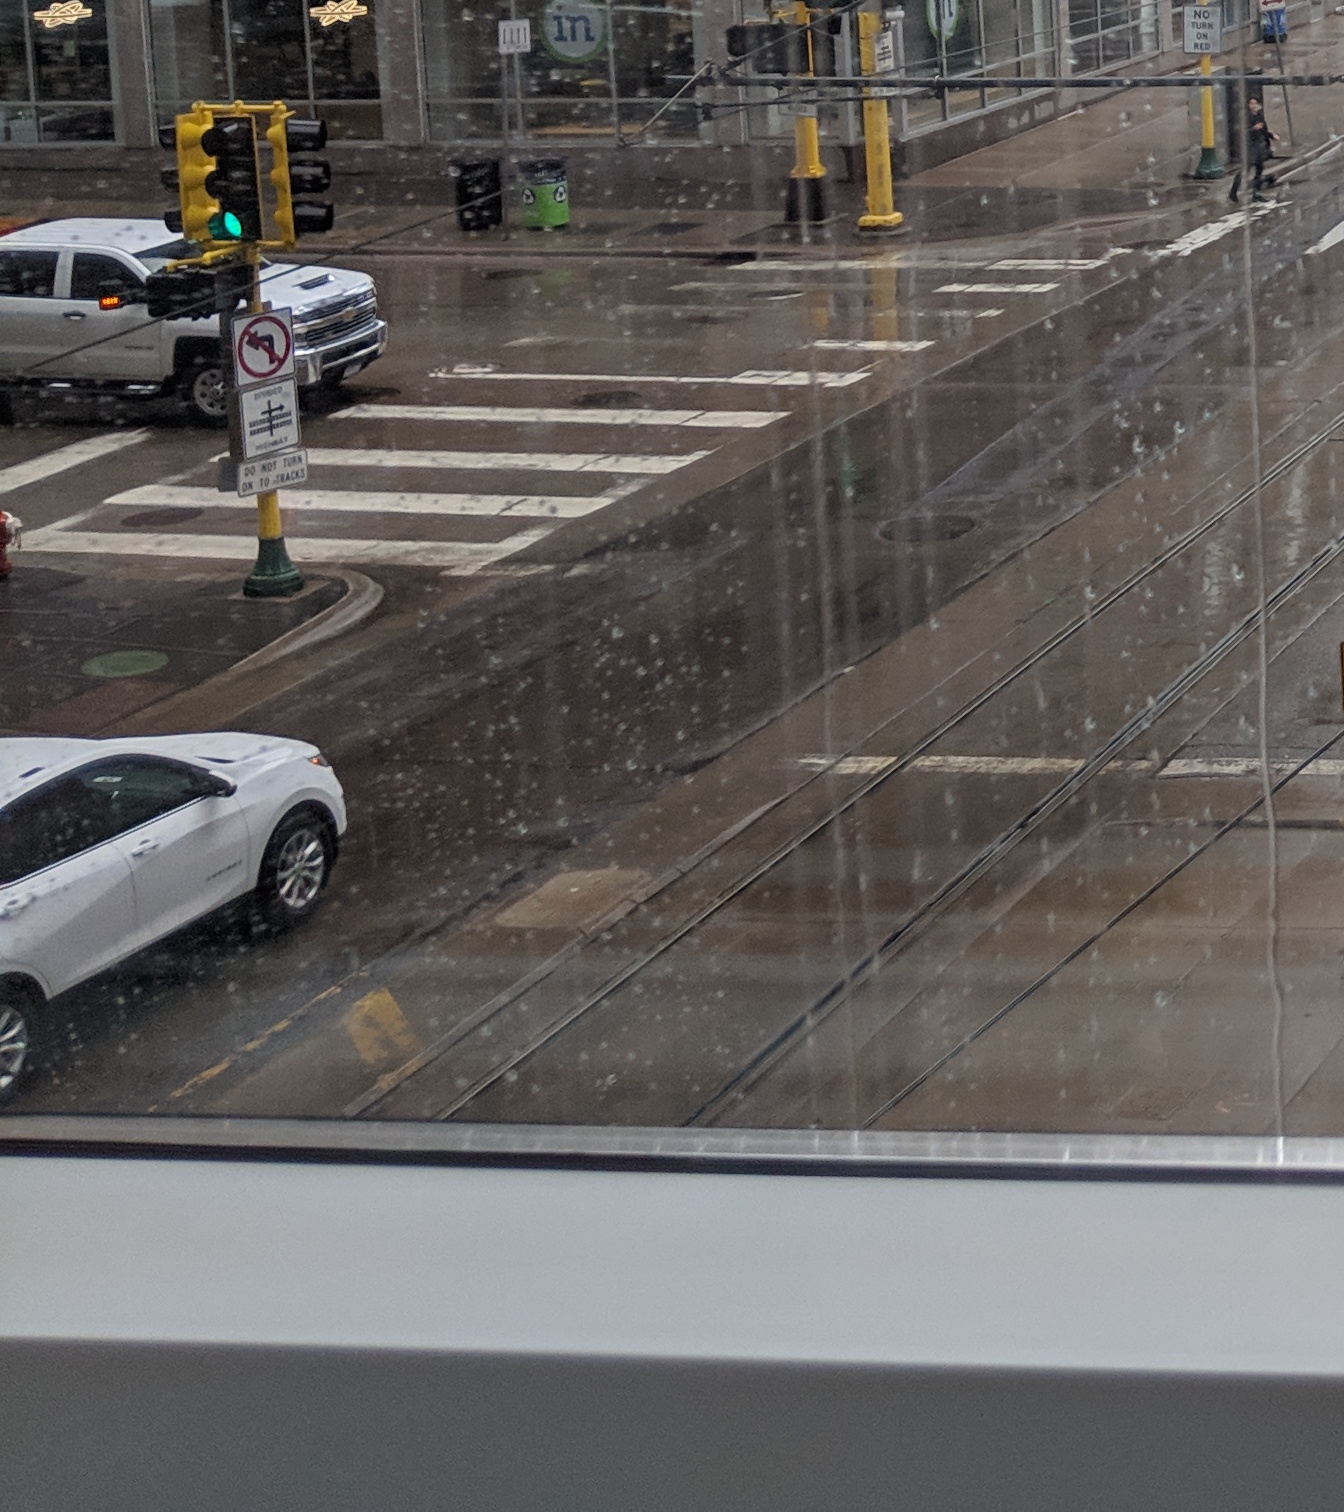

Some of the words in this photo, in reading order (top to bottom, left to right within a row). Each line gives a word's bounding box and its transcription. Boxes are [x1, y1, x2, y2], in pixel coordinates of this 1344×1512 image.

[1193, 9, 1210, 20] NO
[552, 4, 595, 42] in
[1191, 21, 1214, 31] TURN
[1196, 32, 1208, 41] ON
[1193, 42, 1211, 51] RED
[244, 464, 256, 477] DO
[261, 459, 277, 472] NOT
[283, 454, 303, 468] TURN
[242, 481, 254, 492] ON
[260, 476, 270, 488] TO
[276, 468, 305, 484] TRACKS
